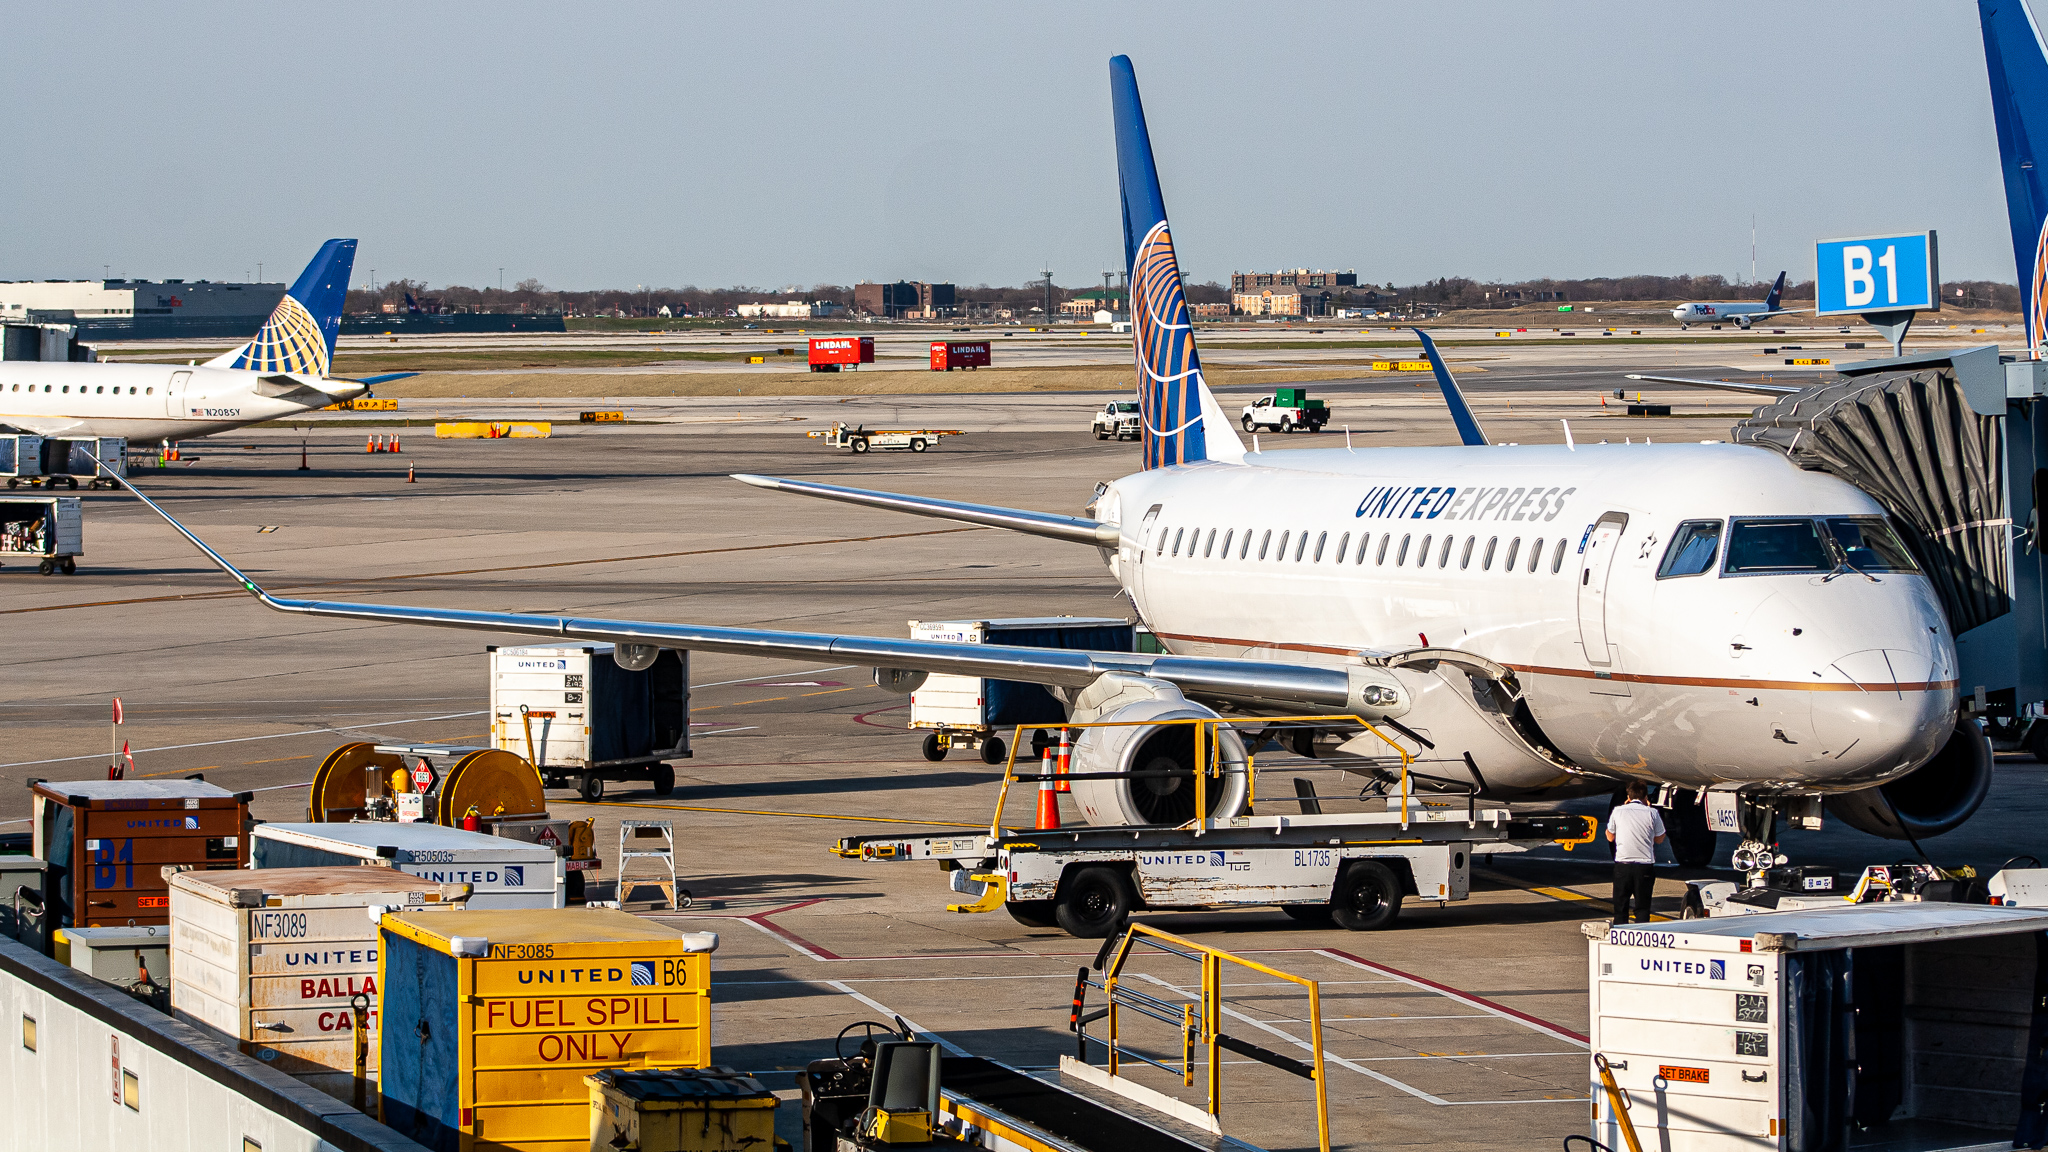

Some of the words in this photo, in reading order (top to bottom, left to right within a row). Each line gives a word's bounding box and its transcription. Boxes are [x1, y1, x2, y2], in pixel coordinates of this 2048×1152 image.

[1843, 245, 1898, 307] B1
[1694, 304, 1716, 316] FedEx
[815, 341, 852, 349] LINDAHL
[952, 346, 986, 354] LINDAHL
[127, 820, 182, 828] UNITED
[1717, 809, 1737, 827] 146SY
[94, 839, 133, 889] B1
[407, 851, 454, 862] SR505035
[1142, 855, 1206, 865] UNITED
[1294, 850, 1330, 867] BL1735
[417, 871, 498, 883] UNITED
[138, 898, 155, 906] SET
[254, 913, 307, 938] NF3089
[1611, 930, 1675, 948] BC020942
[286, 950, 378, 965] UNITED
[494, 945, 554, 959] NF3085
[518, 968, 623, 984] UNITED
[664, 959, 687, 986] B6
[1641, 959, 1705, 975] UNITED
[488, 1000, 575, 1028] FUEL
[586, 997, 679, 1025] SPILL
[538, 1033, 632, 1062] ONLY
[1659, 1067, 1676, 1079] SET
[1679, 1069, 1709, 1082] BRAKE
